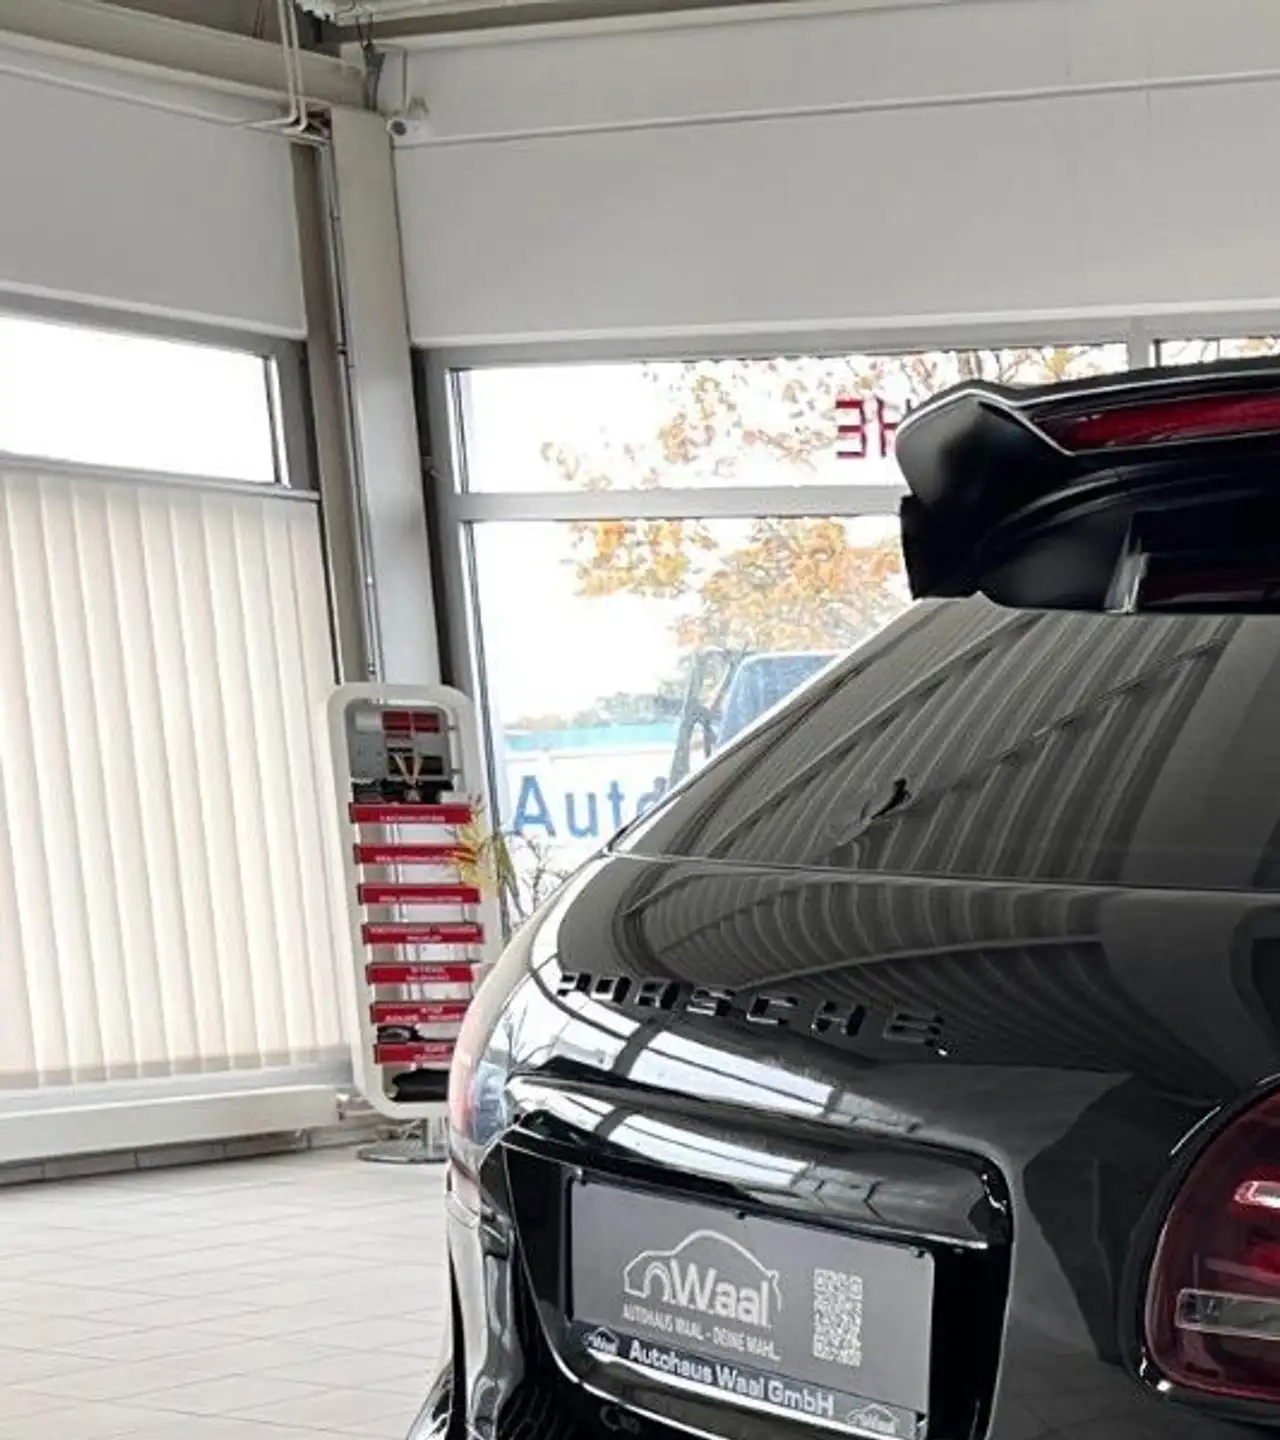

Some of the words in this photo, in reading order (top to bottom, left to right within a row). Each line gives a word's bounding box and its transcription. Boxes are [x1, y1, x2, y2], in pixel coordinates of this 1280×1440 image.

[623, 1302, 673, 1333] AUTOHAUS
[674, 1315, 704, 1341] WAAL
[668, 1257, 771, 1328] Waal
[628, 1339, 713, 1383] Autohaus
[715, 1363, 765, 1398] Waal
[767, 1379, 835, 1417] GmbH
